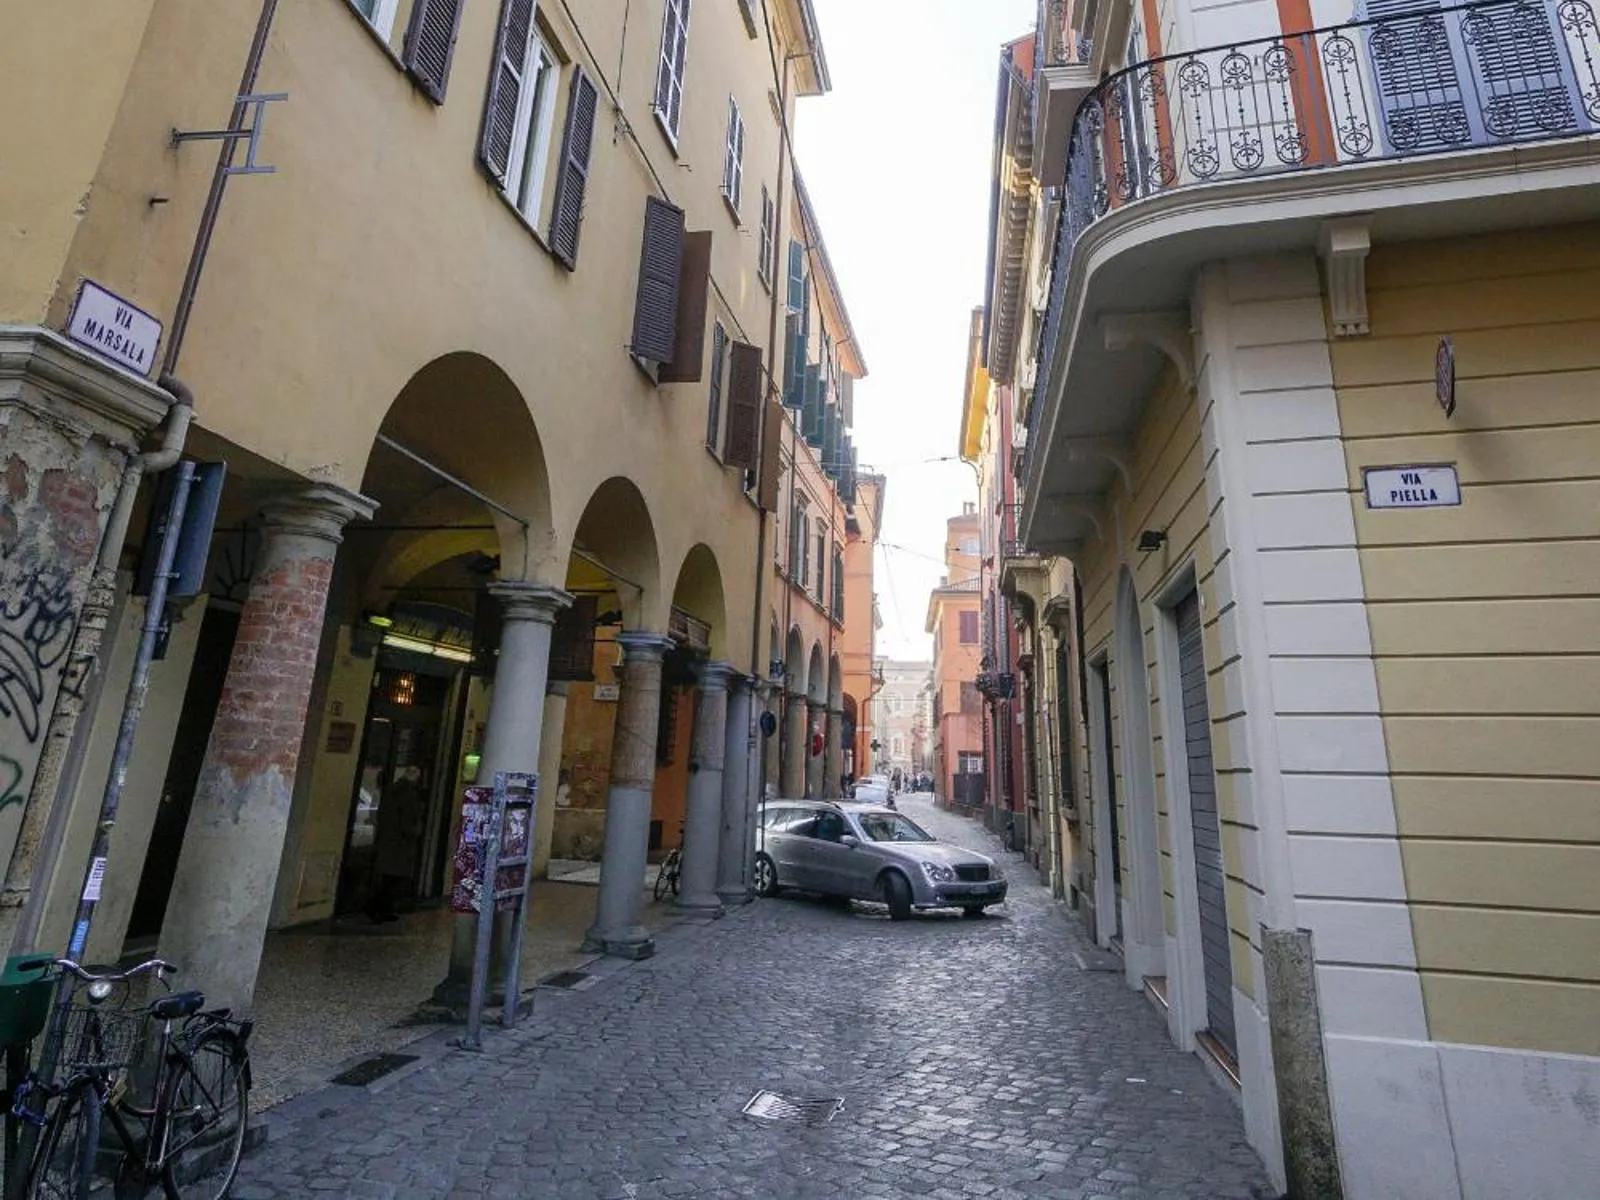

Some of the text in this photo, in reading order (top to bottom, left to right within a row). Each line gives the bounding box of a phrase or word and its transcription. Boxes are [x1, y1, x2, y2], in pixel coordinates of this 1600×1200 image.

[115, 306, 133, 330] VIA
[83, 318, 145, 364] MARSALA
[1401, 473, 1422, 485] VIA
[1390, 488, 1438, 502] PIELLA
